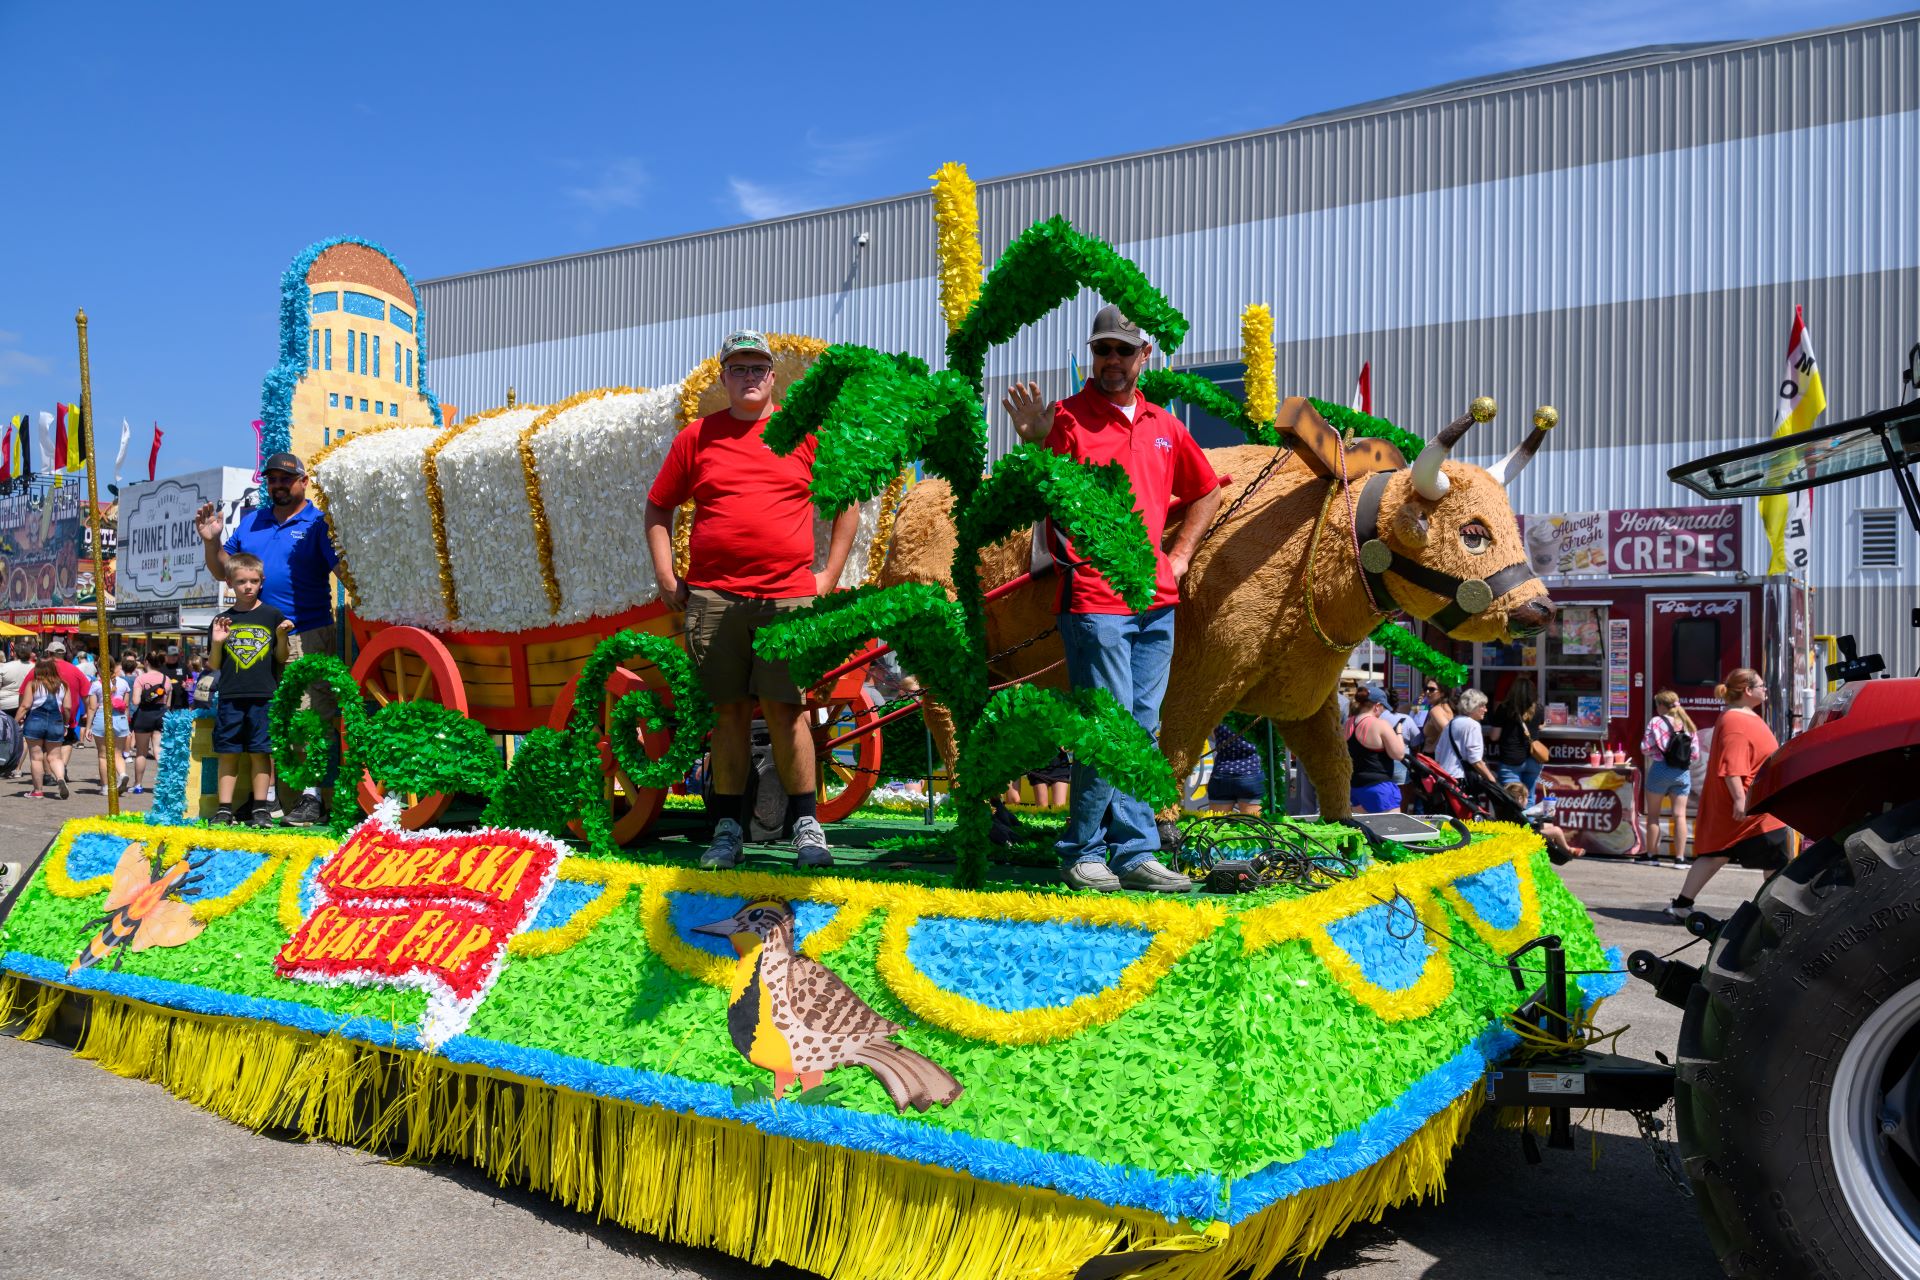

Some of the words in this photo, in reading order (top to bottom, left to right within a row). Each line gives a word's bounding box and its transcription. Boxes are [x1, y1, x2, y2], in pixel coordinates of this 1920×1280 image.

[1552, 512, 1601, 539] Always
[1615, 508, 1735, 533] Homemade
[85, 527, 117, 546] OTL
[132, 523, 168, 555] FUNNEL
[1559, 525, 1604, 552] Fresh
[141, 558, 159, 570] CHERRY
[173, 553, 194, 567] LIMEADE
[1613, 530, 1735, 571] CRÊPES
[41, 613, 55, 625] COLD
[1549, 744, 1588, 759] CRÊPES
[1559, 811, 1612, 831] LATTES
[321, 834, 535, 902] NEBRASKA
[282, 906, 410, 963] STATE
[386, 909, 492, 973] FAIR
